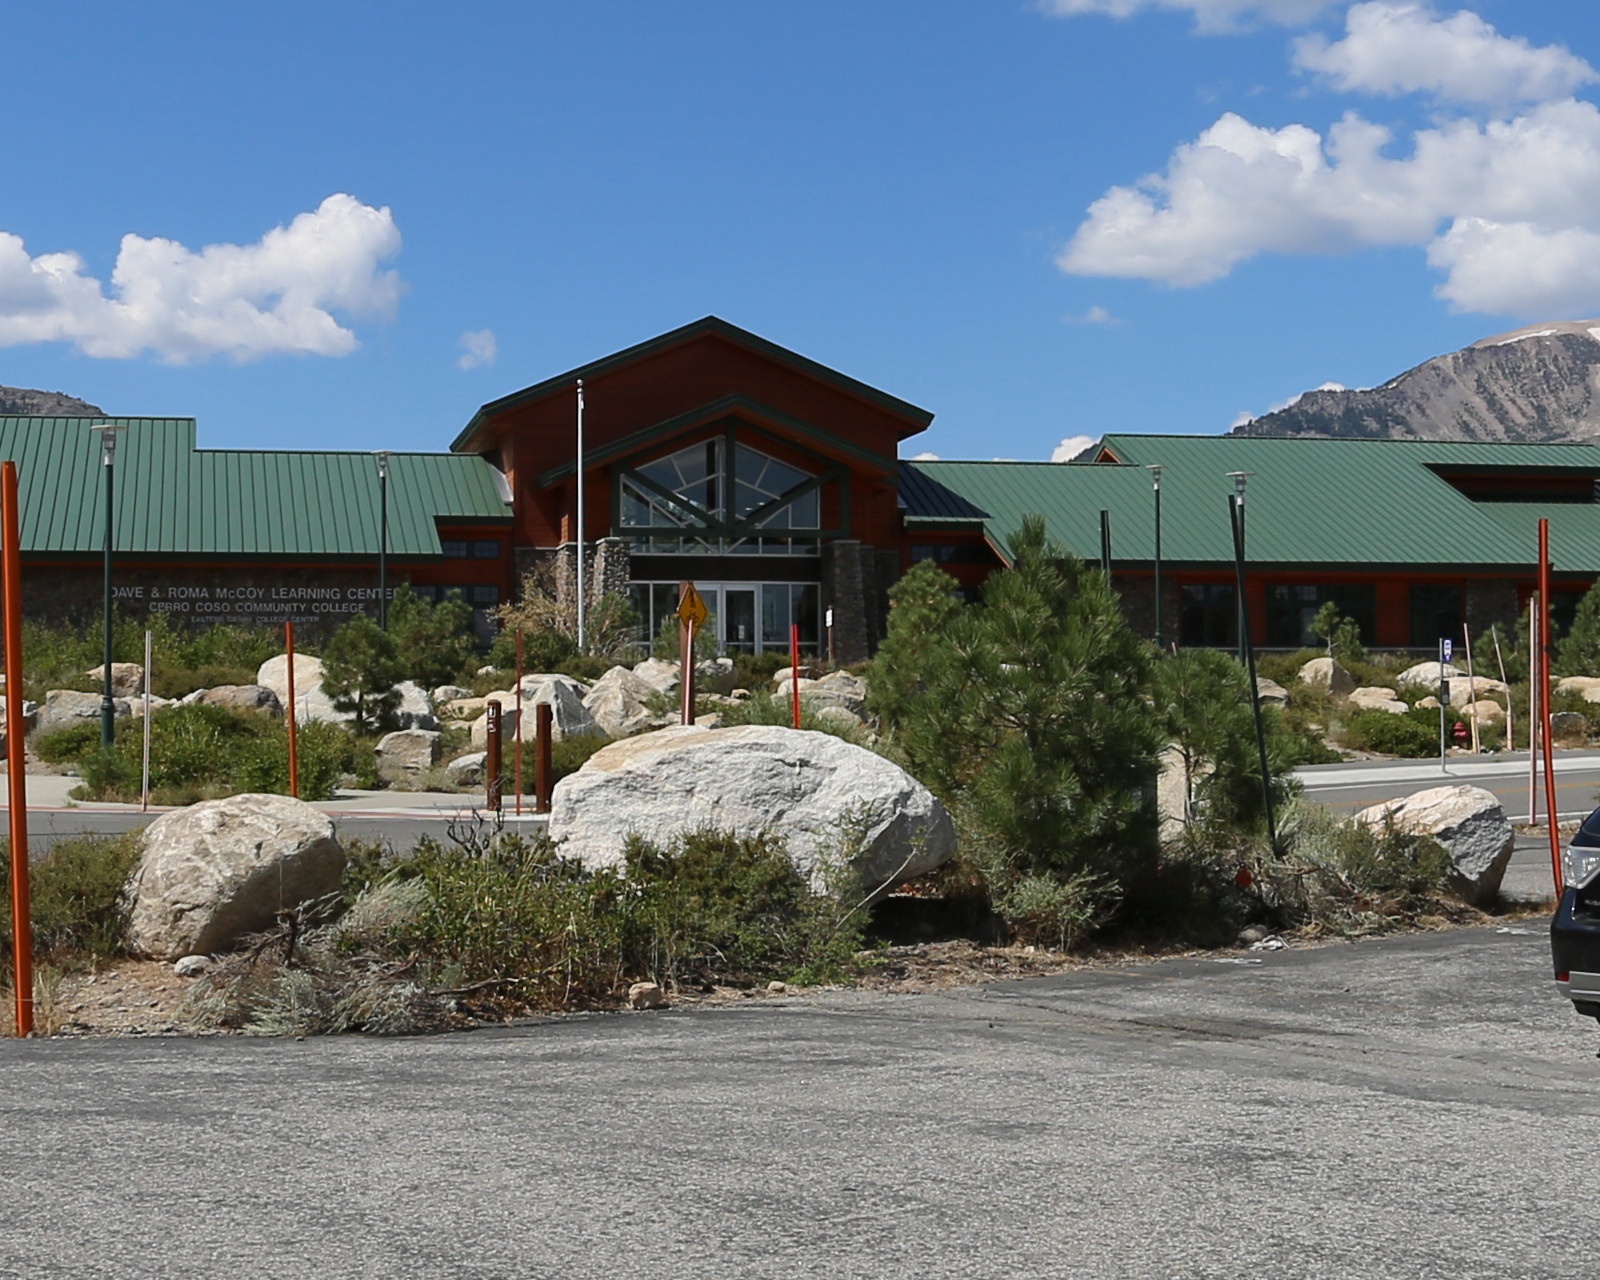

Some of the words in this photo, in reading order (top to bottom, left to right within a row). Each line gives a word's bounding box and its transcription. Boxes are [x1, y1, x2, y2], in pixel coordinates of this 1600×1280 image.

[111, 586, 144, 598] DAVE
[151, 587, 160, 598] &
[168, 587, 209, 599] ROMA
[215, 587, 264, 599] McCOY
[272, 587, 340, 599] LEARNING
[149, 601, 190, 613] CERRO
[195, 601, 230, 613] COSO
[235, 602, 306, 613] COMMUNITY
[311, 602, 365, 613] COLLEGE
